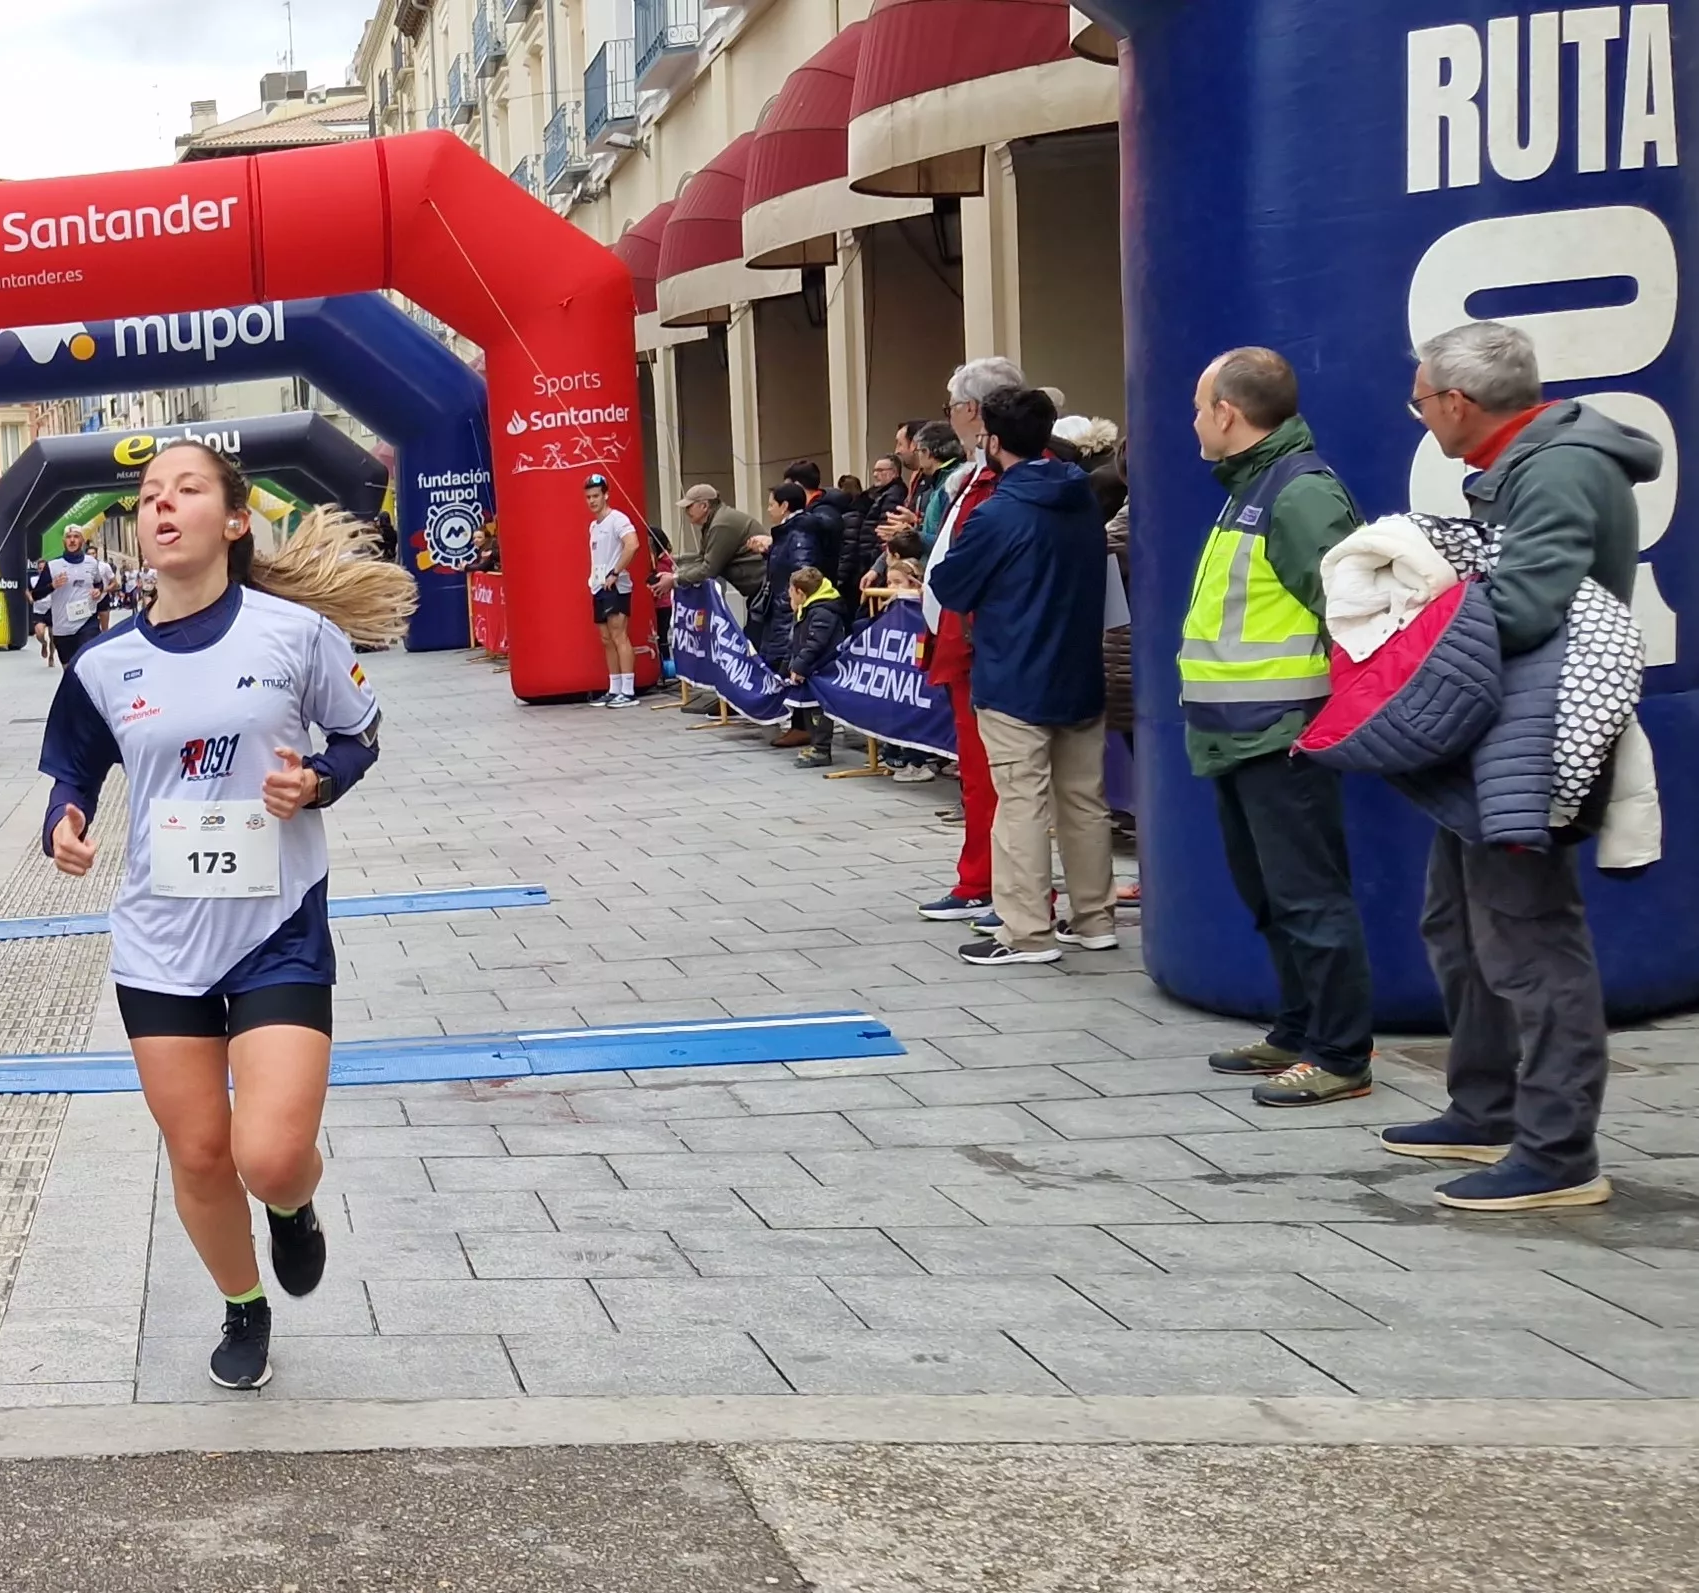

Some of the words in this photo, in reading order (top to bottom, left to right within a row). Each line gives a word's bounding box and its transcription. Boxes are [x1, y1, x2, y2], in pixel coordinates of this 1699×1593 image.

[1407, 3, 1679, 194] RUTA
[2, 194, 239, 253] Santander
[115, 301, 285, 361] mupol
[533, 371, 601, 398] Sports
[530, 403, 629, 431] Santander
[418, 468, 490, 489] fundación
[430, 484, 478, 504] mupol
[831, 658, 932, 709] NACIONAL
[187, 851, 237, 874] 173
